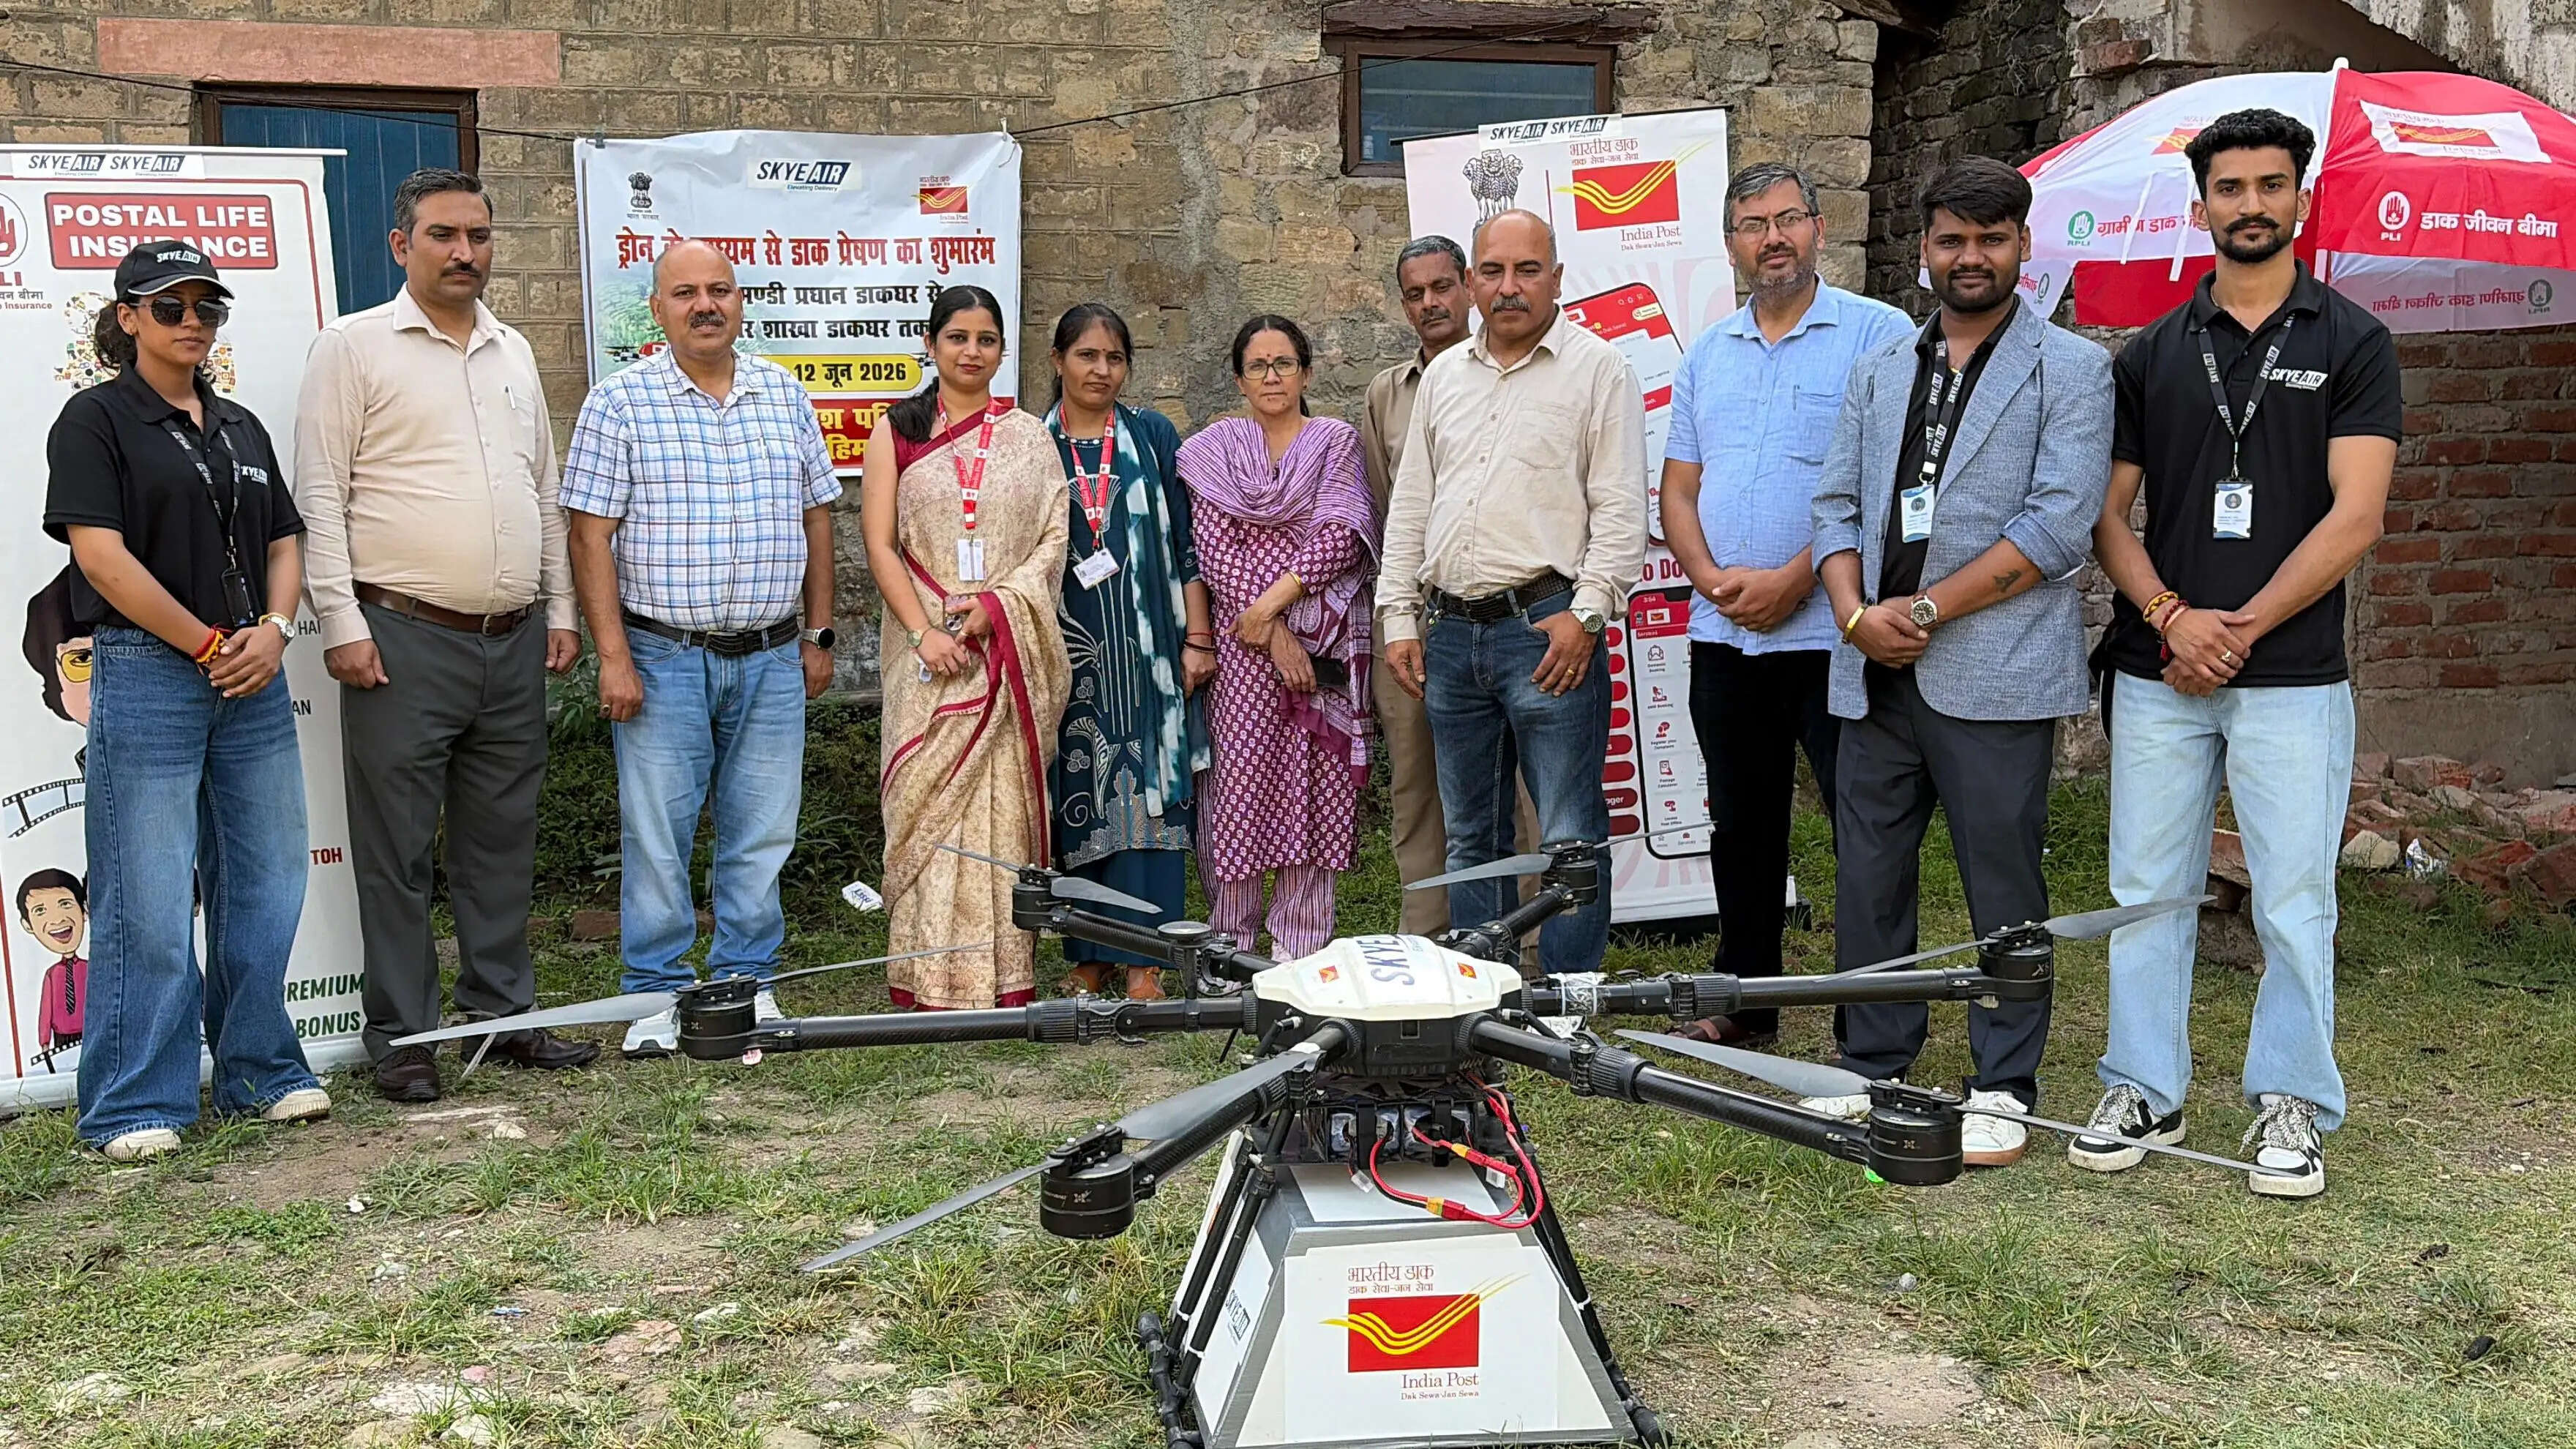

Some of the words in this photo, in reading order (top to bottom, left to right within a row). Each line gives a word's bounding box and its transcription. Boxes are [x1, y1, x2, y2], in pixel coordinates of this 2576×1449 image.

[1570, 138, 1611, 156] भारतीय
[1614, 138, 1639, 151] डाक
[53, 204, 187, 227] POSTAL
[196, 206, 268, 227] LIFE
[2420, 211, 2460, 230] डाक
[2463, 209, 2513, 235] जीवन
[2517, 213, 2558, 238] बीमा
[1620, 228, 1653, 242] India
[1656, 225, 1682, 238] Post
[2149, 217, 2179, 233] डाक
[2381, 231, 2401, 242] PLI
[70, 235, 269, 257] INSNCE
[615, 226, 654, 269] ड्रोन
[763, 229, 782, 265] से
[789, 239, 830, 266] डाक
[837, 231, 888, 266] प्रेषण
[894, 238, 922, 264] का
[929, 228, 995, 274] शुभारंभ
[18, 288, 43, 299] बीमा
[793, 287, 847, 305] प्रधान
[854, 286, 918, 304] डाकघर
[4, 302, 53, 310] Insurance
[761, 320, 818, 339] शाखा
[825, 320, 890, 338] डाकघर
[794, 364, 816, 382] 12
[822, 363, 853, 389] जून
[860, 363, 906, 381] 2026
[310, 847, 342, 865] TOH
[283, 973, 364, 1003] REMIUM
[296, 1011, 361, 1038] BONUS
[1348, 1261, 1401, 1282] भारतीय
[1404, 1265, 1434, 1280] डाक
[1348, 1286, 1367, 1294] डाक
[1416, 1281, 1434, 1292] सेवा
[1402, 1373, 1442, 1389] India
[1447, 1371, 1479, 1387] Post
[1401, 1392, 1416, 1400] Dak
[1459, 1389, 1479, 1397] Sewa
